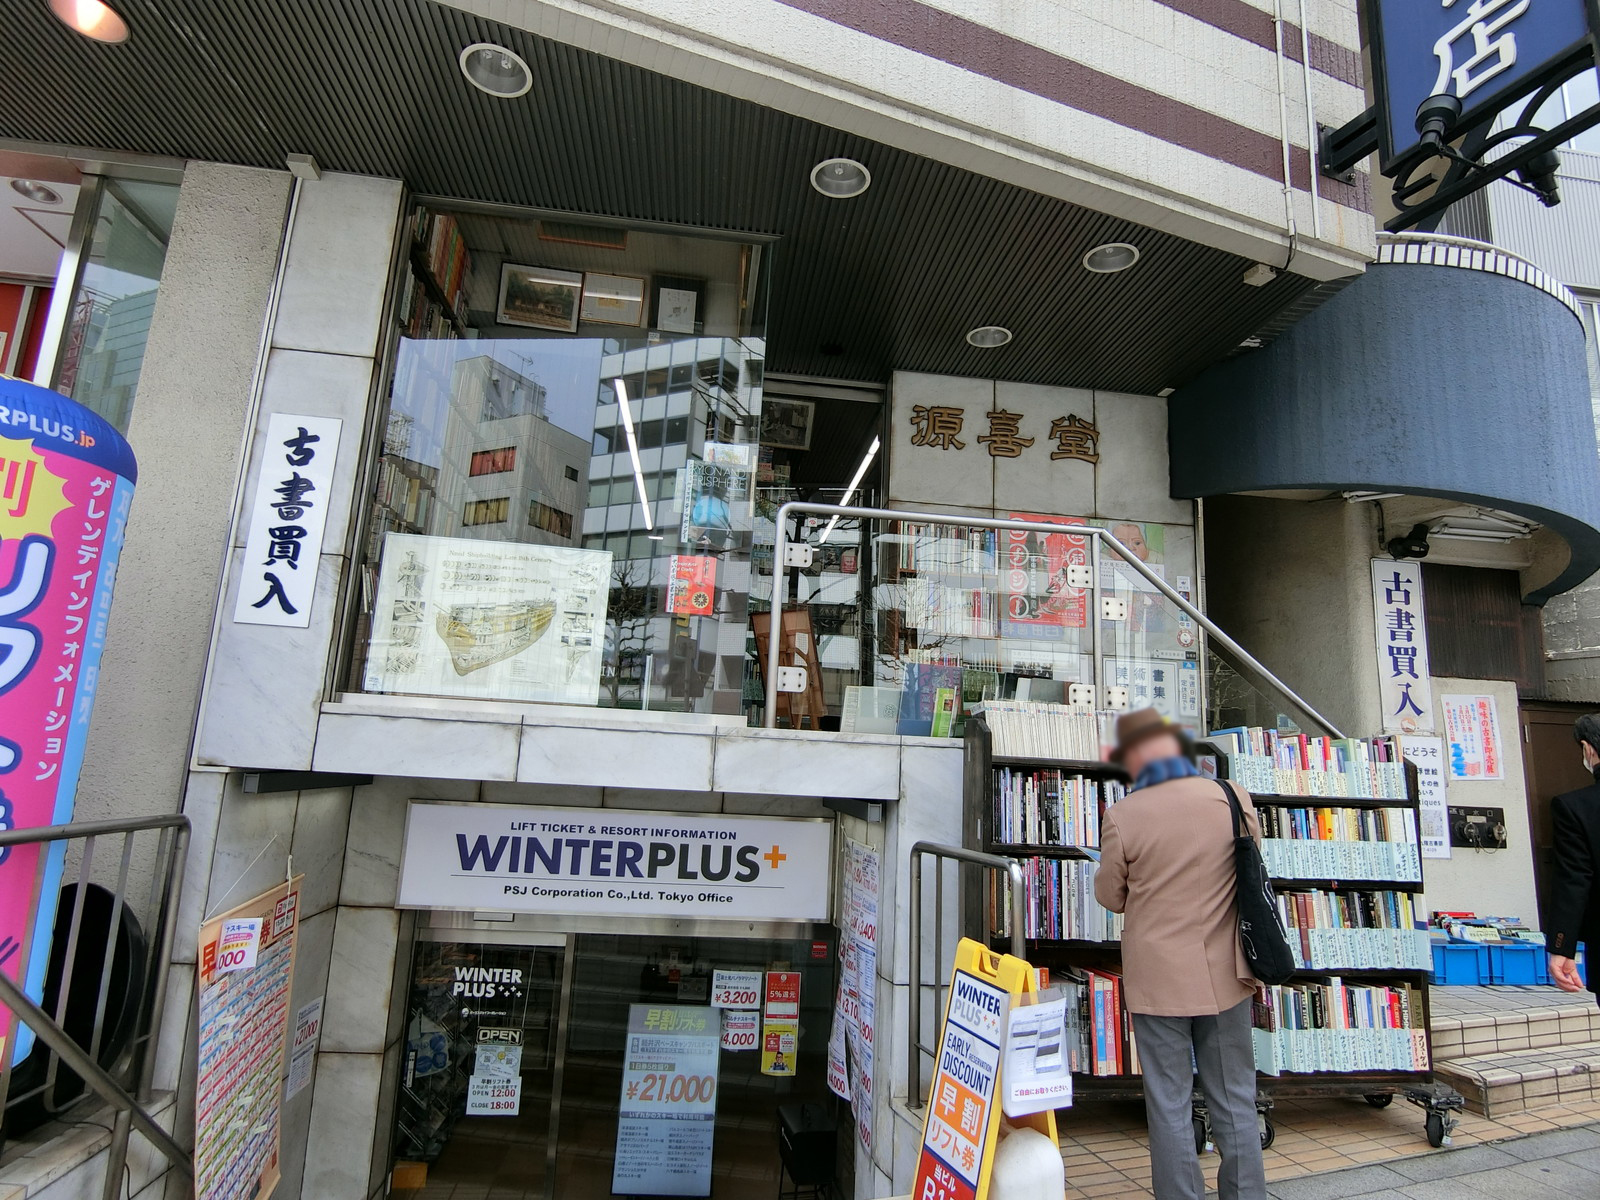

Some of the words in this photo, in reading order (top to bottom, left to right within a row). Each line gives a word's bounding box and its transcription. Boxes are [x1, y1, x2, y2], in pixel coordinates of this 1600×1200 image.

[910, 404, 1100, 465] 源喜堂
[251, 426, 321, 615] 古書買入
[35, 475, 113, 782] ゲレンデインフォメーション
[1381, 571, 1424, 717] 古書買入
[510, 821, 537, 832] LIFT
[540, 823, 585, 834] TICKET
[588, 825, 597, 834] &
[600, 825, 649, 837] RESORT
[650, 828, 737, 841] INFORMATION
[503, 885, 528, 896] PSJ
[531, 887, 604, 899] Corporation
[607, 889, 654, 902] Co.,Ltd.
[658, 891, 694, 903] Tokyo
[697, 892, 733, 903] Office
[454, 966, 522, 984] WINTER
[453, 982, 496, 998] PLUS
[714, 990, 757, 1004] ¥3,200
[956, 979, 1001, 1018] WINTER
[953, 1000, 982, 1026] PLUS
[478, 1029, 520, 1043] OPEN
[946, 1032, 971, 1058] EARLY
[943, 1052, 991, 1097] DISCOUNT
[490, 1089, 516, 1098] 12:00
[626, 1073, 716, 1104] ¥21,000
[490, 1101, 515, 1110] 18:00
[939, 1083, 982, 1137] 早割
[930, 1120, 976, 1172] リフト券
[922, 1175, 955, 1200] B1
[934, 1163, 956, 1192] 当ビル
